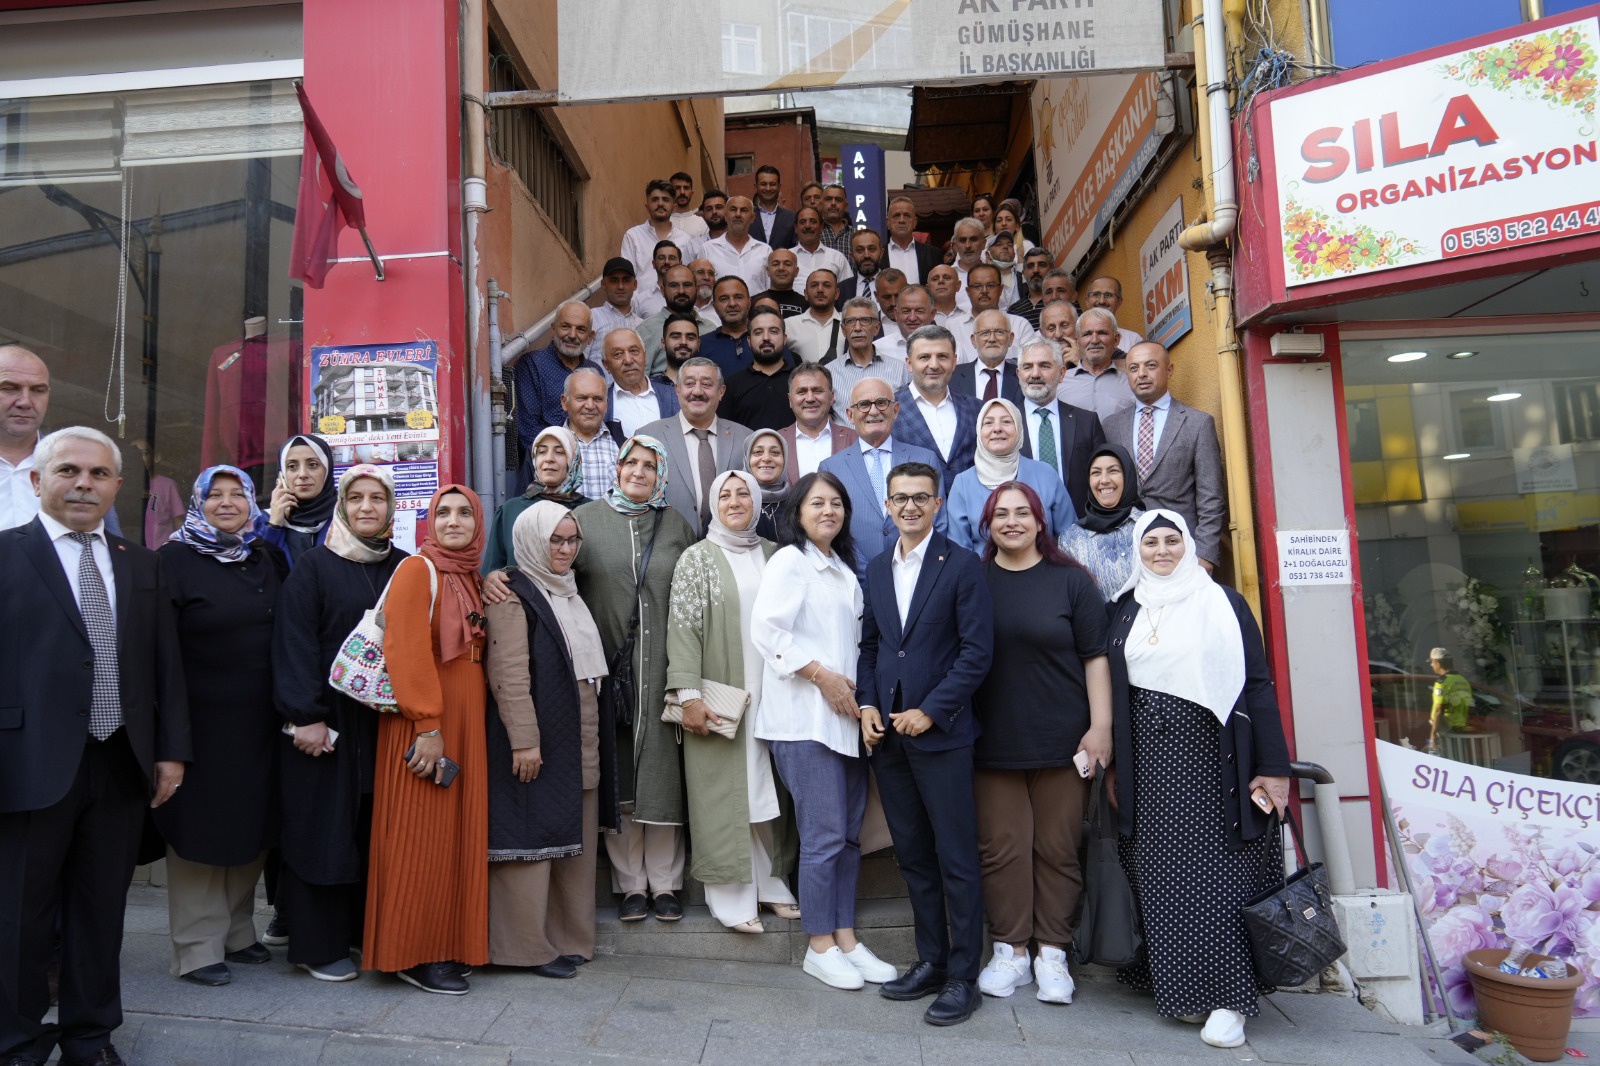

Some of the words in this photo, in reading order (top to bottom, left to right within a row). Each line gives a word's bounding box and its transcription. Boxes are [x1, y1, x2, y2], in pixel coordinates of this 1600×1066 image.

[958, 19, 1095, 47] GÜMÜŞHANE
[959, 51, 977, 75] İL
[1300, 93, 1501, 185] SILA
[1335, 140, 1598, 215] ORGANİZASYON
[1075, 175, 1095, 223] İLÇE
[1461, 226, 1502, 248] 553
[1506, 217, 1547, 241] 522
[1552, 211, 1580, 232] 44
[1585, 206, 1600, 226] 4
[1148, 247, 1159, 272] AK
[1146, 258, 1184, 324] SKM
[319, 349, 371, 367] ZÜMRA
[375, 345, 432, 363] EVLERİ
[410, 500, 422, 509] 54
[1287, 547, 1317, 556] KİRALIK
[1318, 547, 1342, 555] DAİRE
[1290, 534, 1338, 544] SAHİBİNDEN
[1283, 560, 1298, 568] 2+1
[1299, 558, 1348, 568] DOĞALGAZLI
[1288, 572, 1308, 580] 0531
[1325, 571, 1344, 579] 4524
[1411, 763, 1477, 802] SILA
